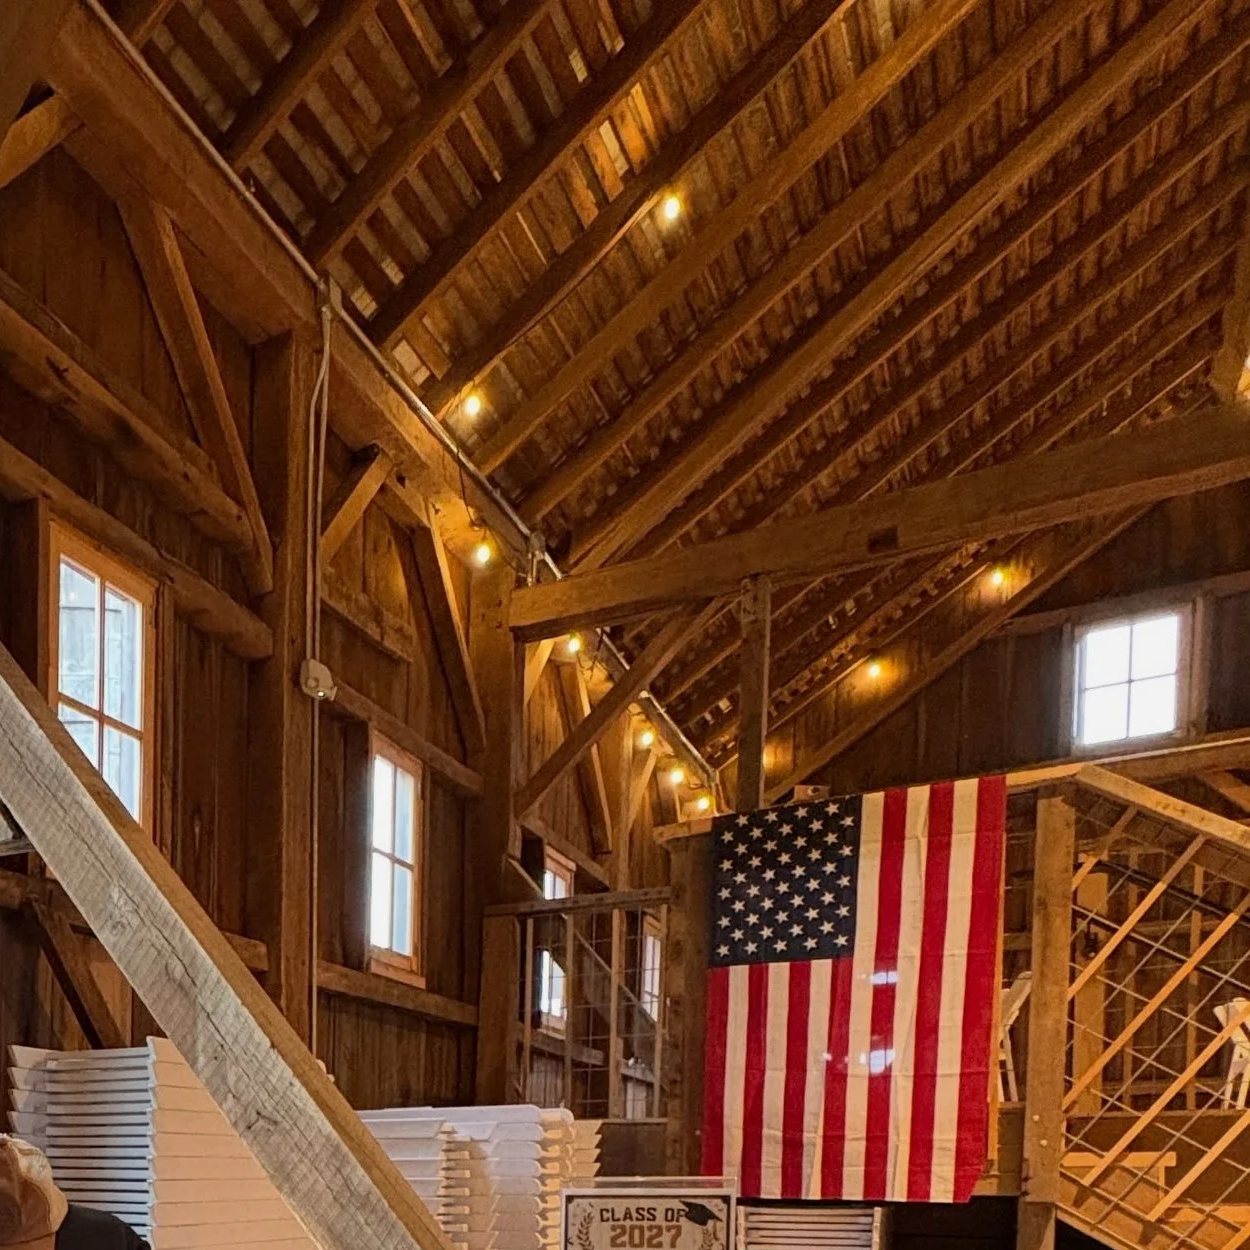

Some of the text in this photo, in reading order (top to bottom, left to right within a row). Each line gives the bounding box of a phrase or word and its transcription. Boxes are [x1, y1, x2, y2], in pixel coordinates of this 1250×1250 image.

[600, 1207, 687, 1224] CLASS OF
[610, 1224, 682, 1249] 2027
